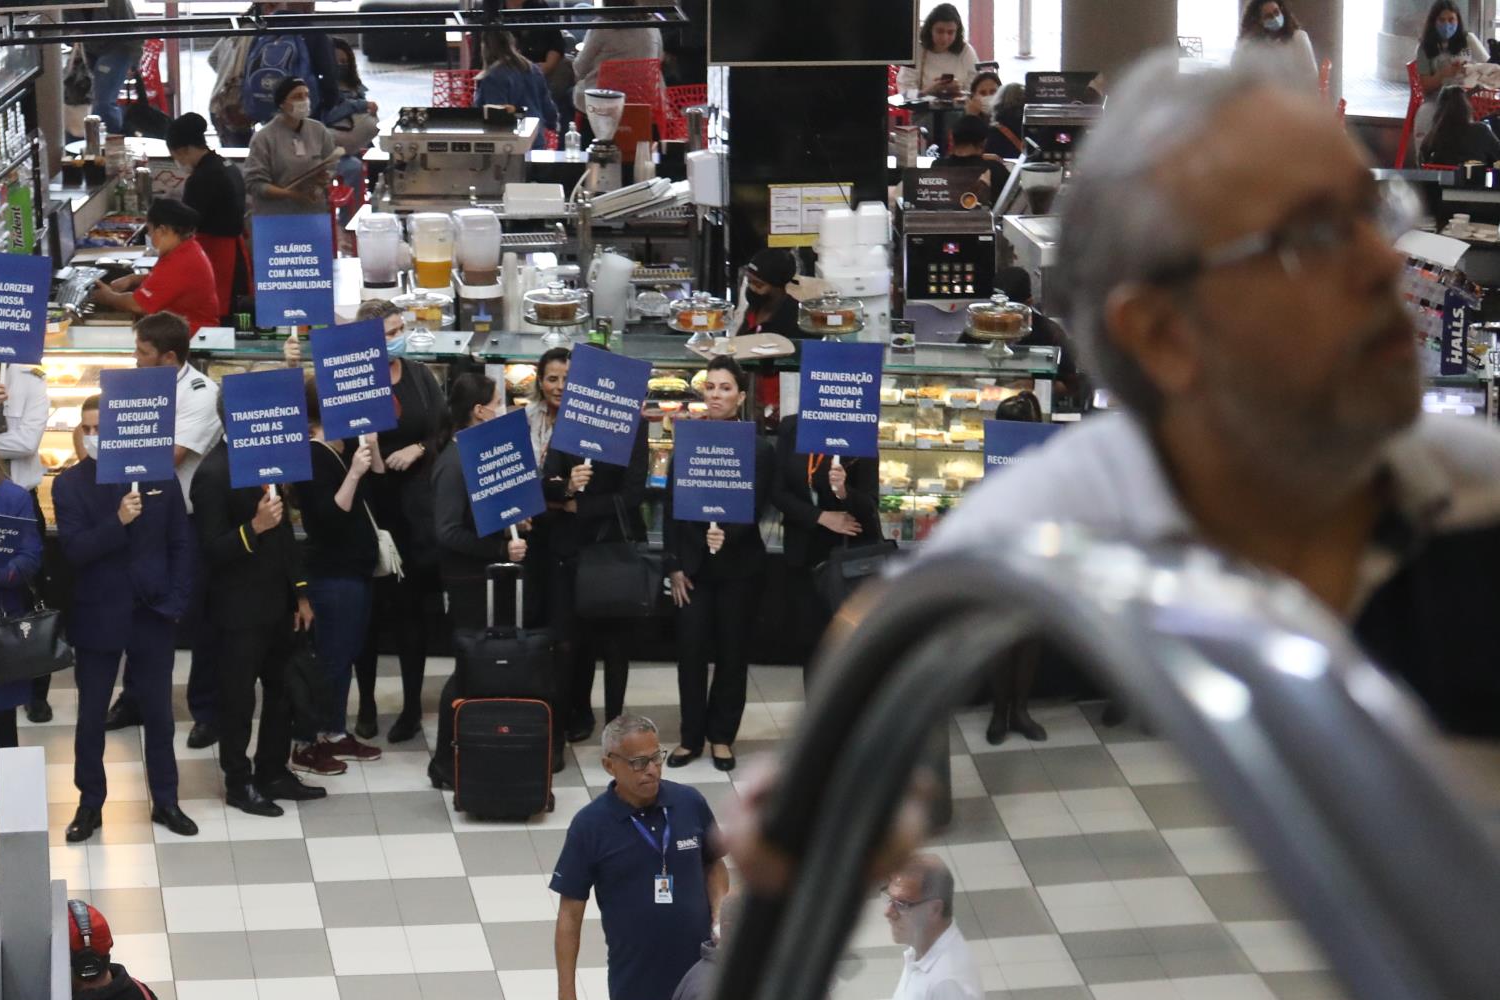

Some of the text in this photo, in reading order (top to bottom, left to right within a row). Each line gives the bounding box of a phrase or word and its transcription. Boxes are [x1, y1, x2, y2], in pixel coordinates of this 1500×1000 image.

[12, 207, 23, 248] Trident
[274, 243, 312, 253] SALÁRIOS
[269, 255, 318, 265] COMPATÍVEIS
[268, 268, 320, 278] COM A NOSSA
[258, 280, 332, 290] RESPONSABILIDADE
[323, 348, 380, 367] REMUNERAÇÃO
[334, 364, 374, 379] ADEQUADA
[811, 371, 873, 384] REMUNERAÇÃO
[336, 375, 375, 391] TAMBÉM É
[598, 378, 615, 389] NÃO
[819, 385, 863, 395] ADEQUADA
[109, 396, 168, 408] REMUNERAÇÃO
[323, 387, 390, 407] RECONHECIMENTO
[567, 398, 633, 421] AGORA É A HORA
[819, 398, 861, 409] TAMBÉM É
[117, 412, 159, 422] ADEQUADA
[231, 406, 300, 421] TRANSPARÊNCIA
[802, 410, 877, 422] RECONHECIMENTO
[251, 422, 283, 433] COM AS
[565, 410, 630, 433] DA RETRIBUIÇÃO
[118, 424, 158, 435] TAMBÉM É
[101, 437, 172, 449] RECONHECIMENTO
[233, 433, 302, 448] ESCALAS DE VOO
[480, 442, 514, 461] SALÁRIOS
[696, 445, 734, 455] SALÁRIOS
[477, 452, 521, 474] COMPATÍVEIS
[690, 457, 740, 466] COMPATÍVEIS
[479, 463, 525, 486] COM A NOSSA
[688, 468, 706, 476] COM
[715, 470, 741, 478] NOSSA
[471, 470, 537, 502] RESPONSABILIDADE
[677, 479, 753, 489] RESPONSABILIDADE
